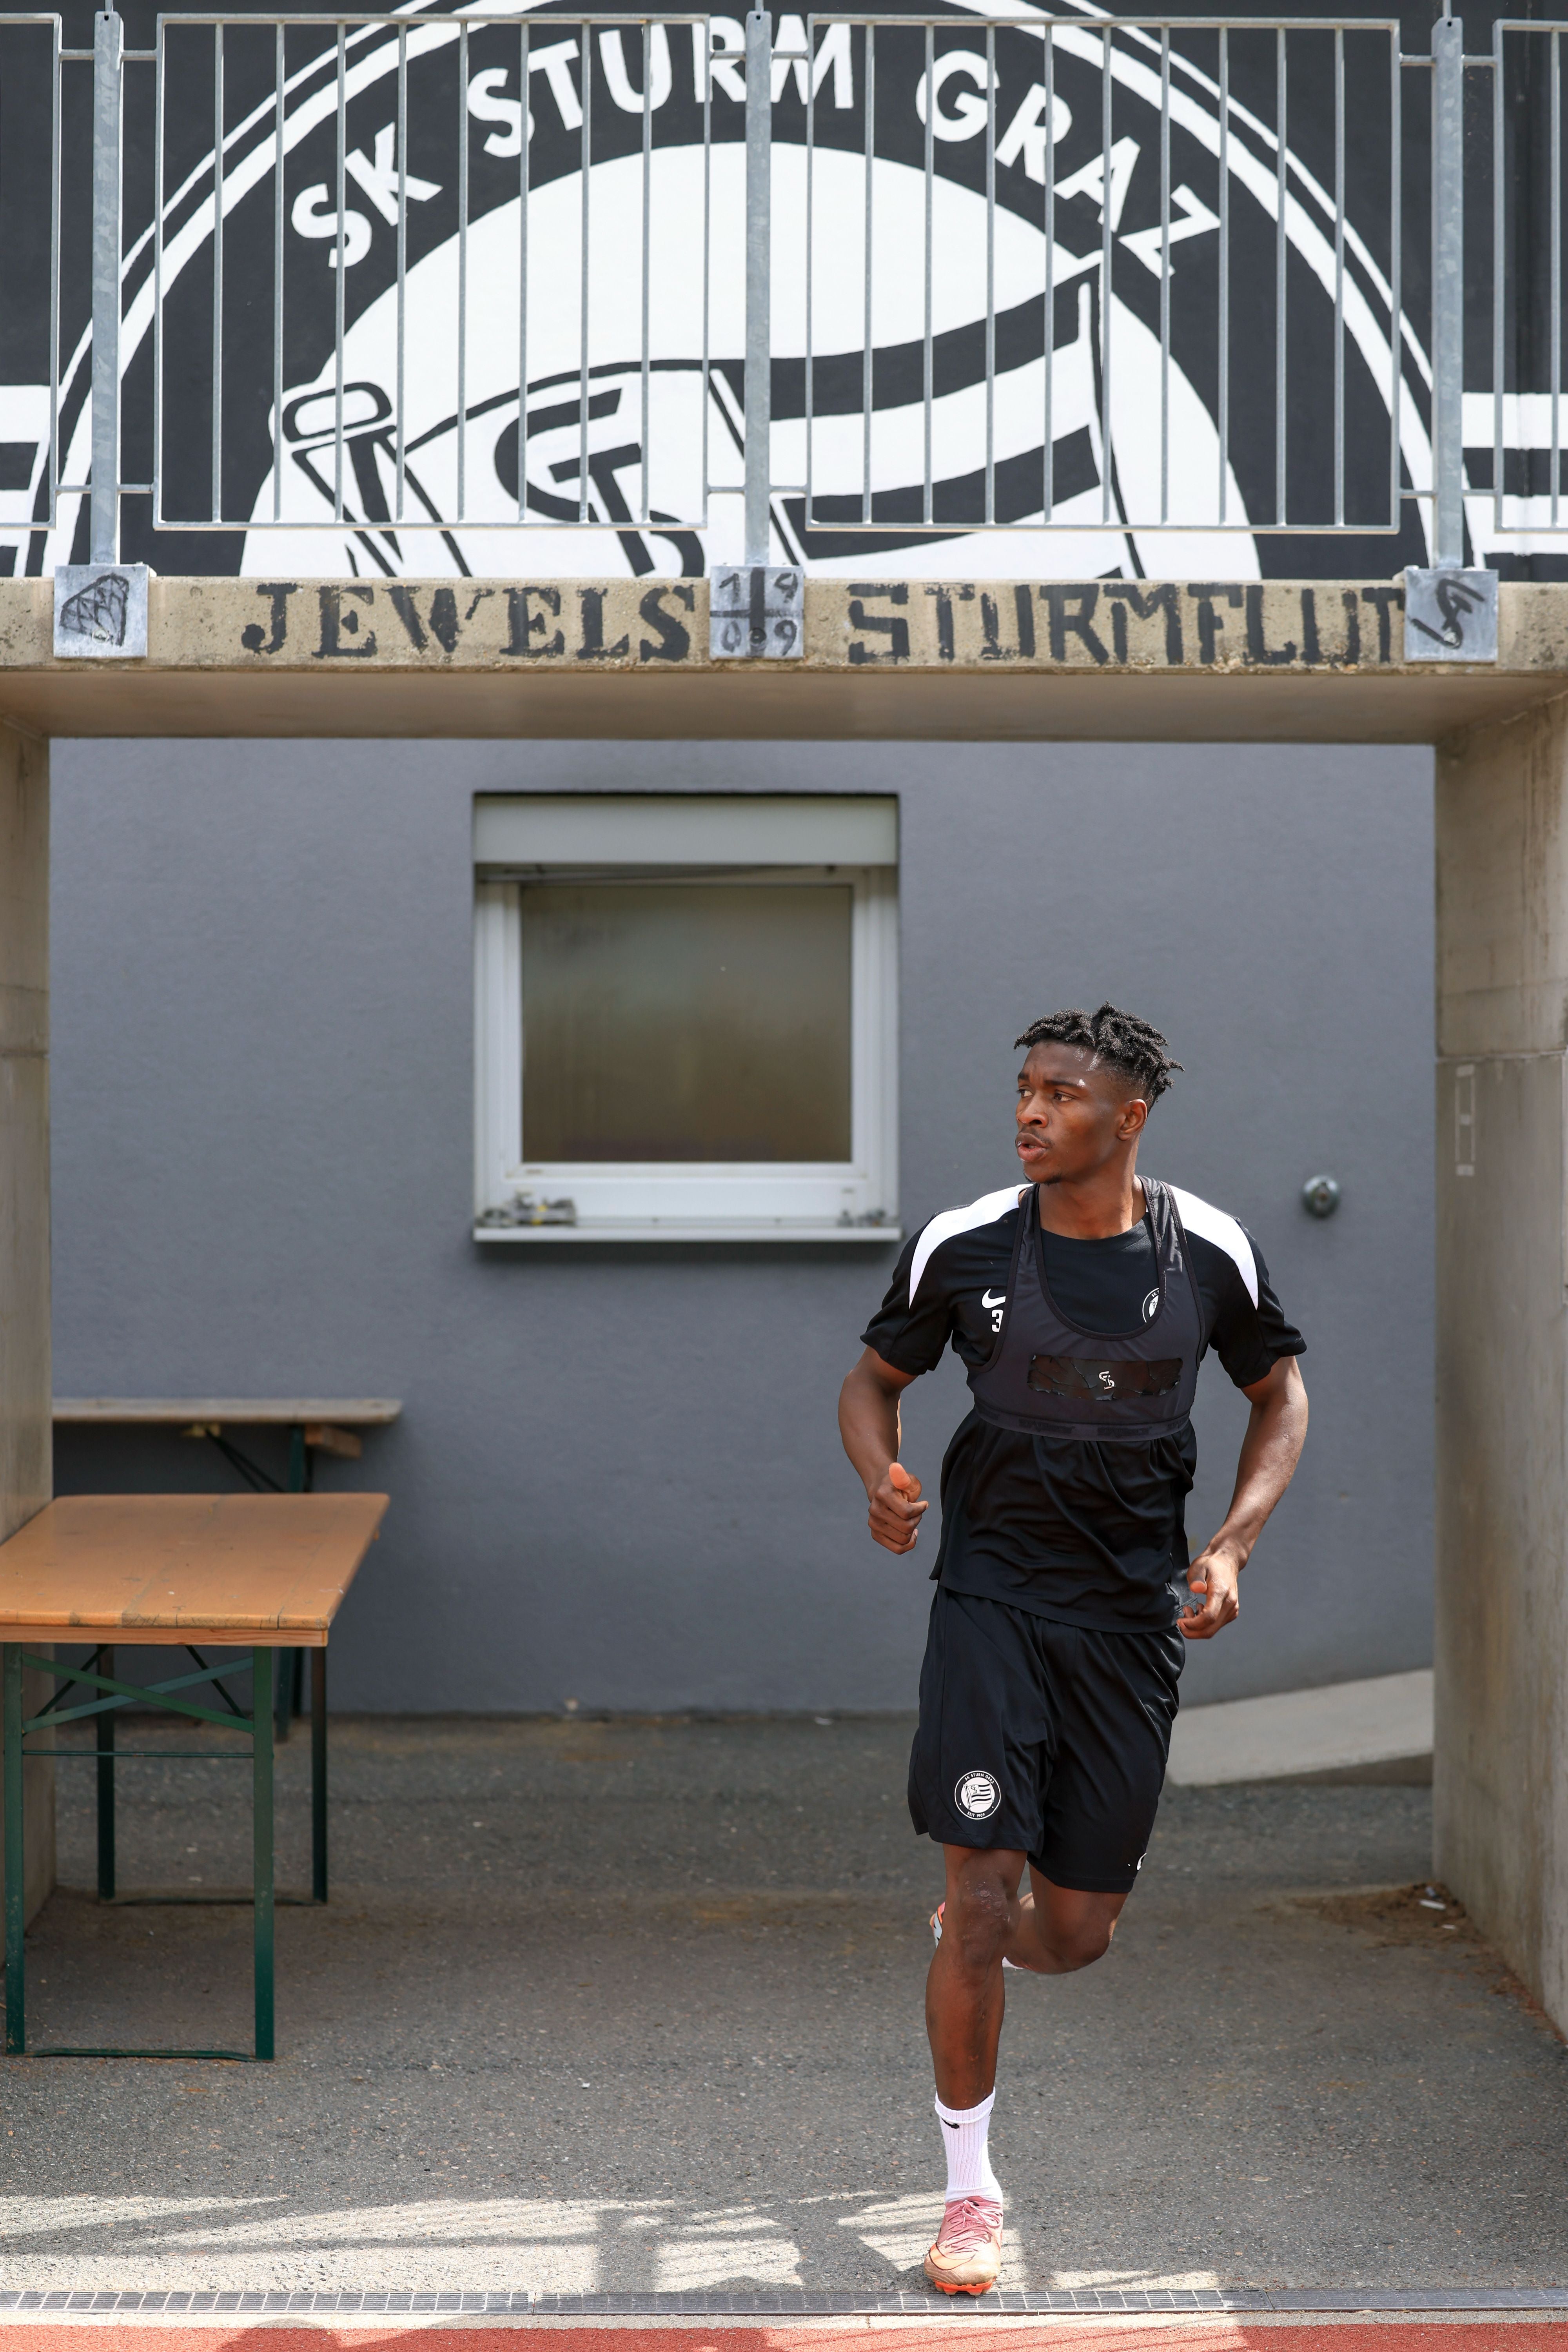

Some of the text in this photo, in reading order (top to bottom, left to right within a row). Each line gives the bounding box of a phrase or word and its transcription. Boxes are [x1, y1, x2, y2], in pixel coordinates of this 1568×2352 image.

[291, 15, 1221, 279] SK STURM GRAZ
[241, 583, 1405, 666] JEWELS STURMFLUT
[985, 1775, 995, 1784] GRAZ
